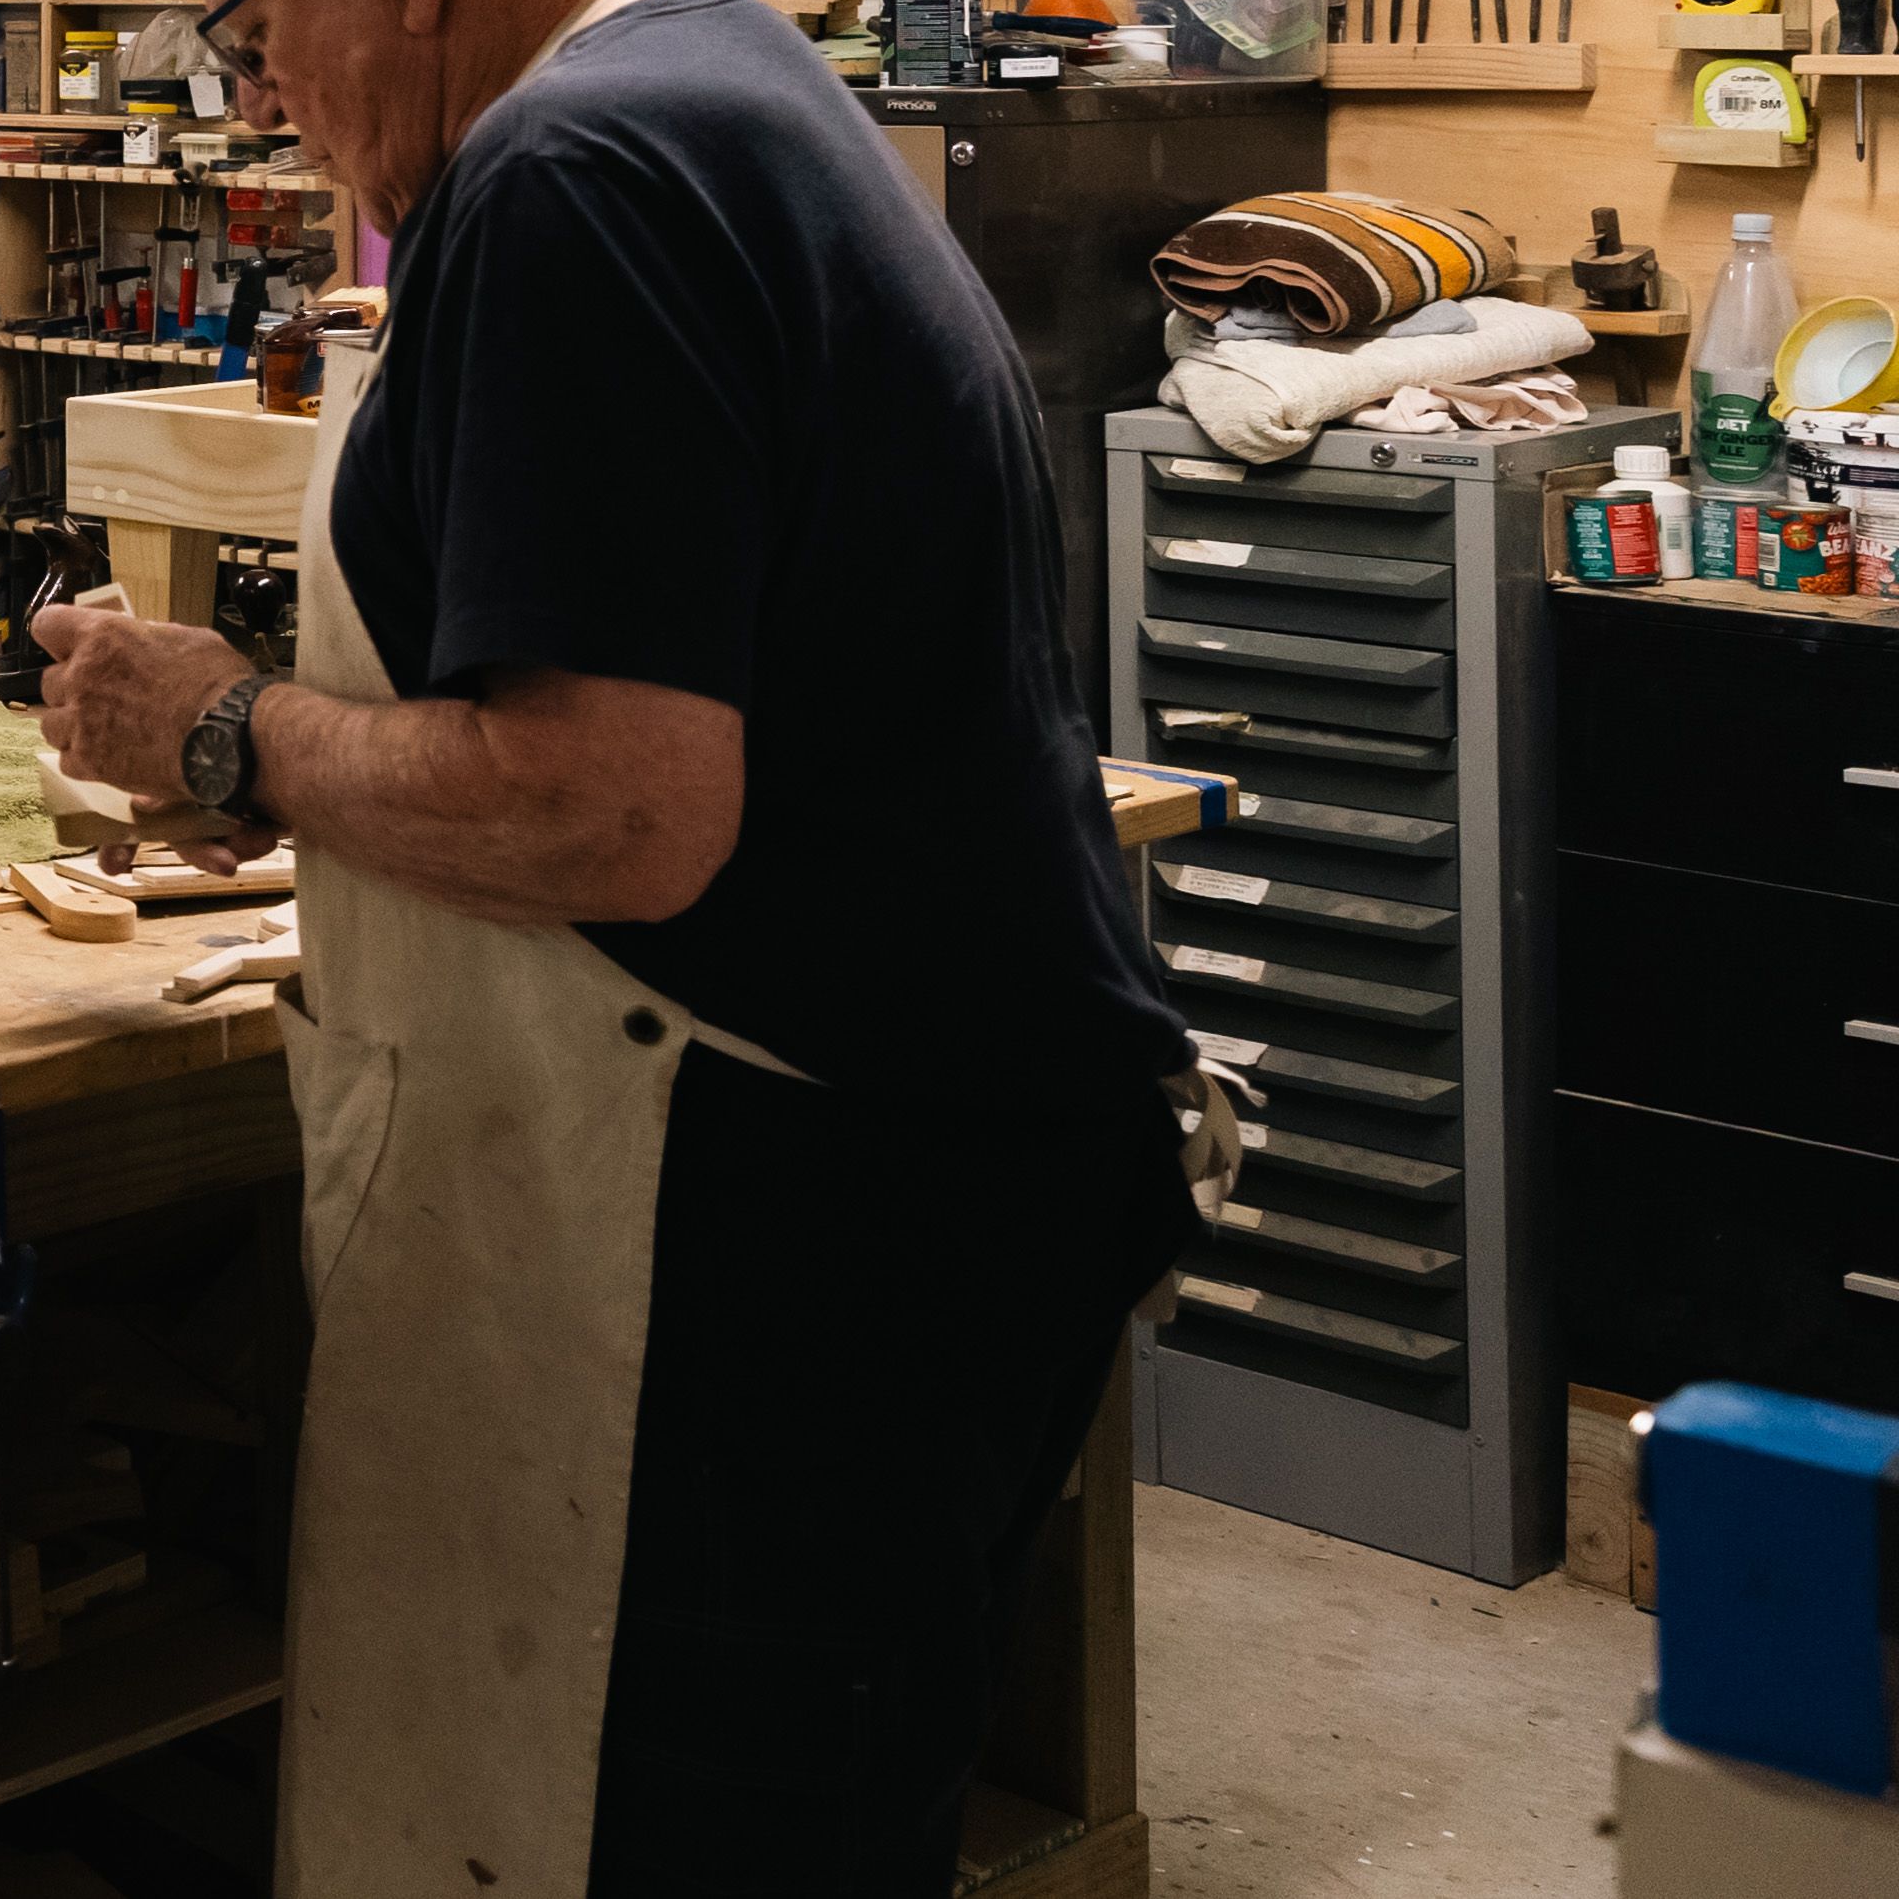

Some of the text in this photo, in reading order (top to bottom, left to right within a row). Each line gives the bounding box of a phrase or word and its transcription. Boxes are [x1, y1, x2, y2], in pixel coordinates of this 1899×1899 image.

[886, 100, 937, 111] Precision
[1759, 99, 1782, 109] 8M
[1717, 418, 1751, 432] DIET
[1818, 538, 1851, 557] BEA
